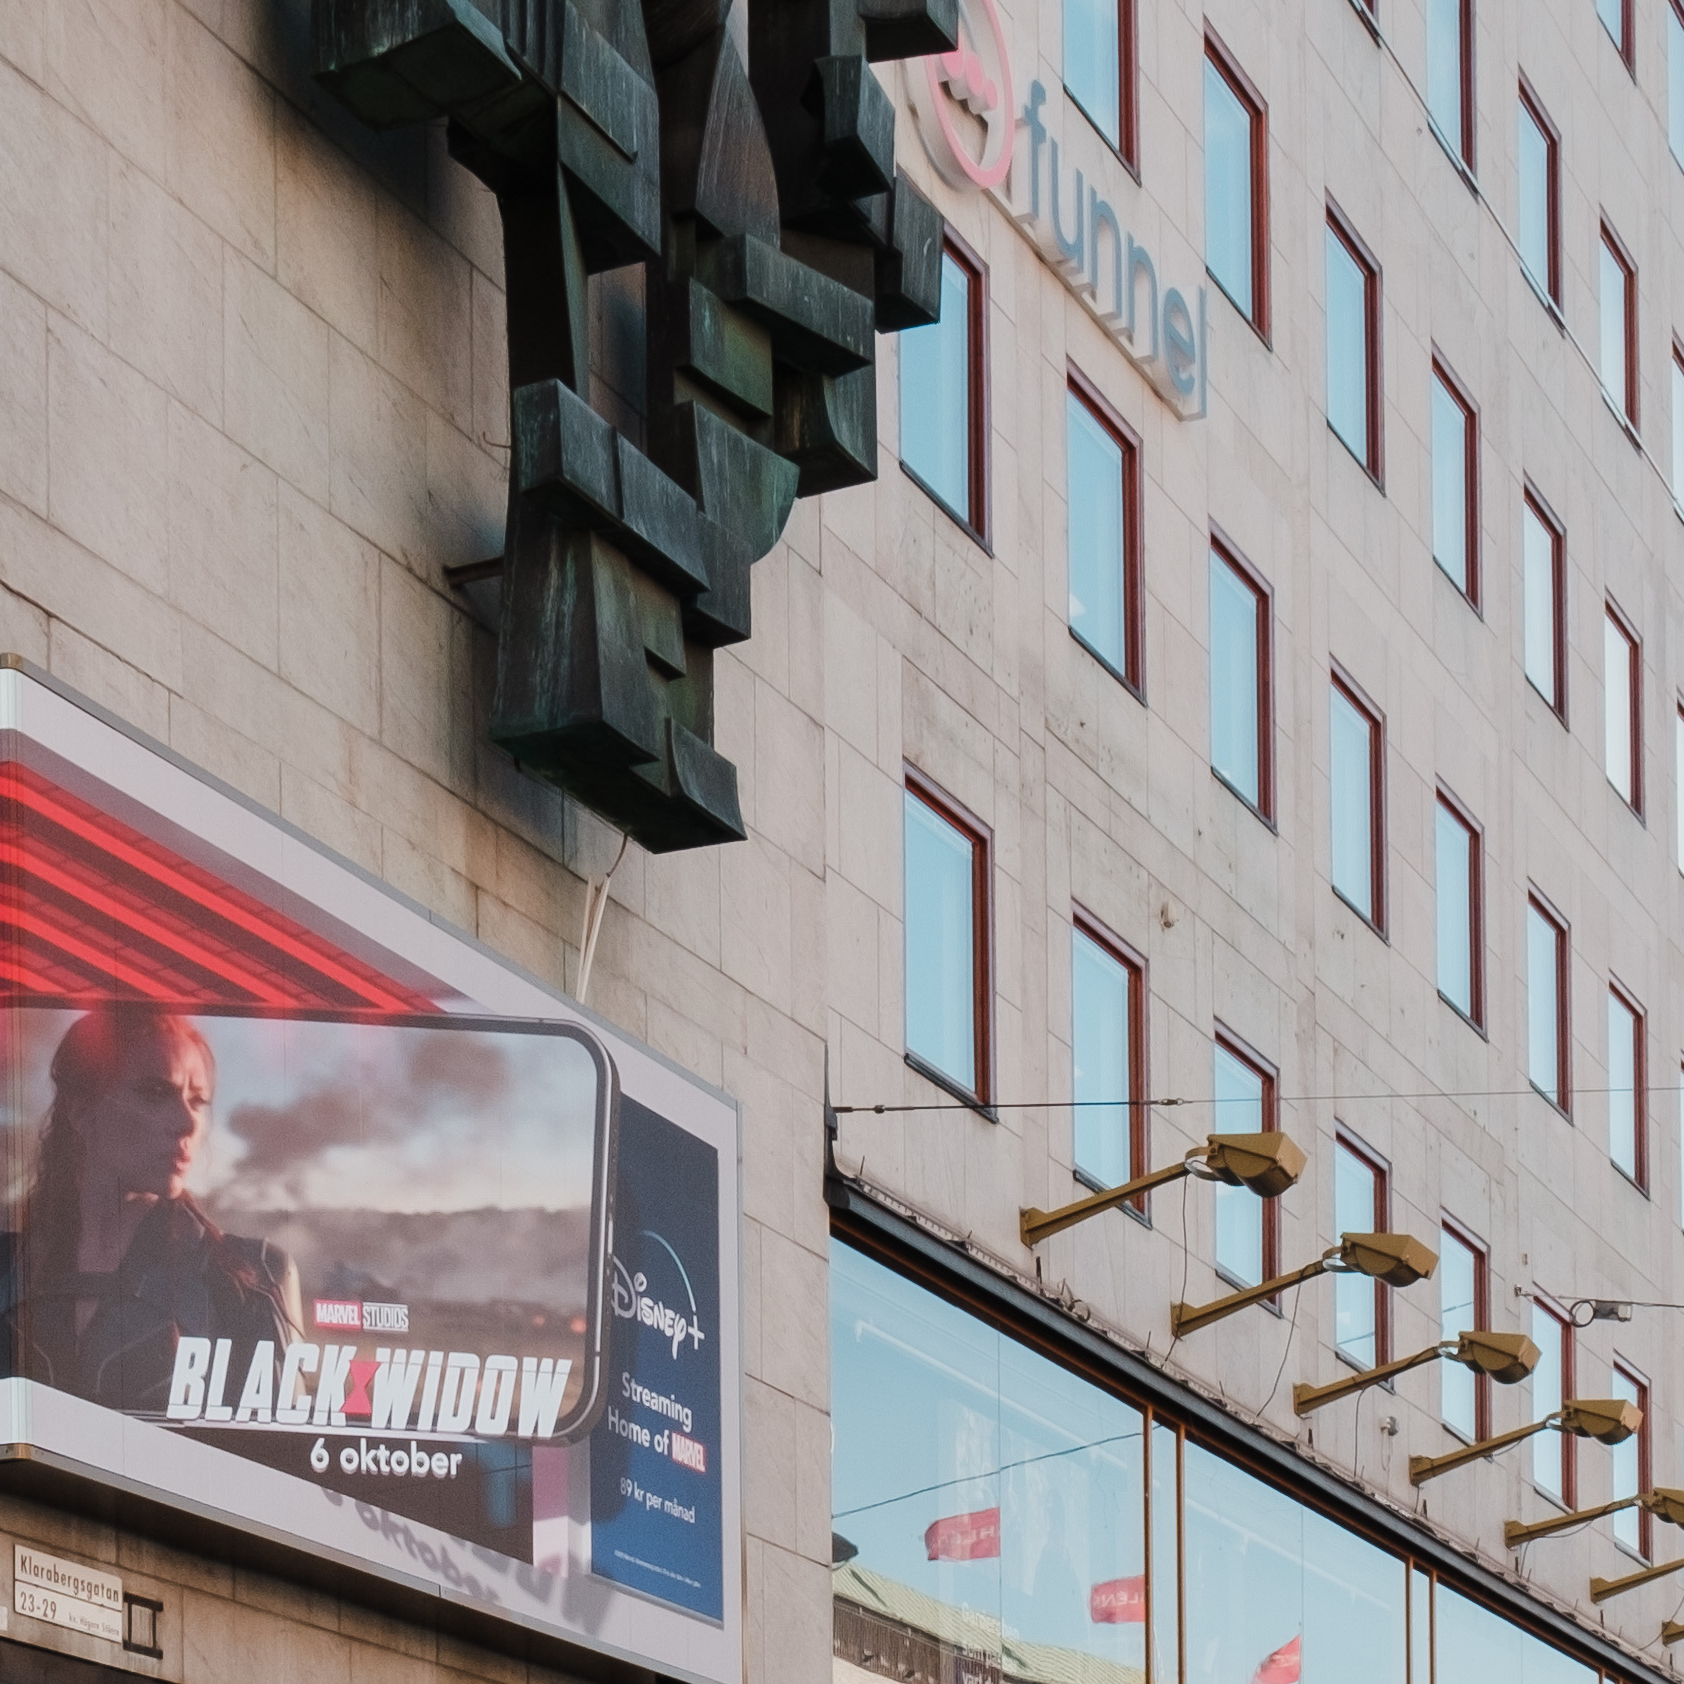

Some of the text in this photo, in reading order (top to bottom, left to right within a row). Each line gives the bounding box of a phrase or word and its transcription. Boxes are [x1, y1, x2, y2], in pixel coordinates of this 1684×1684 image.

[316, 1301, 409, 1331] MARVEL STUDIOS
[165, 1337, 573, 1439] BLACK WIDOW
[620, 1371, 693, 1433] Streaming
[309, 1438, 463, 1478] 6 oktober
[608, 1405, 706, 1473] Home of MARVEL
[619, 1477, 695, 1524] 89 kr per månad
[20, 1554, 120, 1602] Klarabergsgatan
[20, 1591, 58, 1619] 23-29
